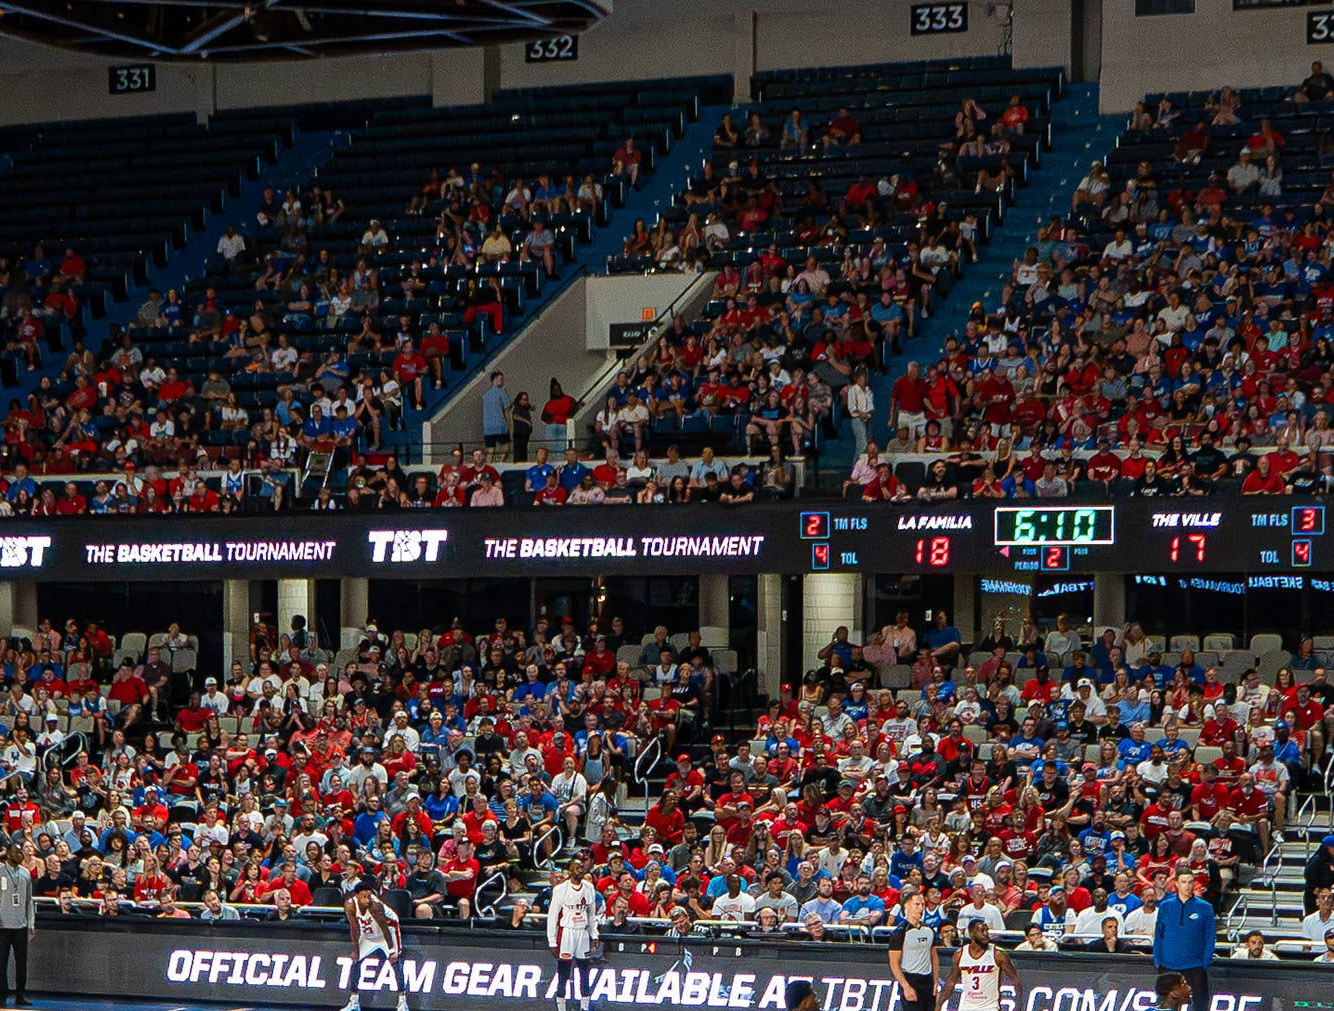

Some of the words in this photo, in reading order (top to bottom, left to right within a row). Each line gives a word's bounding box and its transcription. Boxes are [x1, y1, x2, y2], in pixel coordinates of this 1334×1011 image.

[915, 4, 964, 31] 333
[529, 33, 574, 59] 332
[116, 67, 150, 91] 331
[806, 514, 822, 537] 2
[897, 516, 916, 530] LA
[916, 515, 972, 530] FAMILIA
[1013, 509, 1096, 543] 6:10
[1152, 513, 1180, 527] THE
[1180, 512, 1222, 527] VILLE
[1251, 514, 1267, 527] TM
[1269, 514, 1289, 527] FLS
[1301, 508, 1316, 531] 3
[85, 544, 115, 564] THE
[117, 543, 223, 563] BASKETBALL
[225, 541, 337, 561] TOURNAMENT
[368, 529, 448, 563] TBT
[483, 538, 519, 559] THE
[520, 537, 638, 558] BASKETBALL
[640, 535, 765, 557] TOURNAMENT
[814, 545, 828, 564] 4
[841, 552, 859, 565] TOL
[915, 536, 950, 567] 18
[1046, 547, 1061, 568] 2
[1170, 533, 1206, 563] 17
[1260, 550, 1279, 564] TOL
[1294, 543, 1310, 562] 4
[166, 949, 327, 989] OFFICIAL
[335, 955, 437, 993] TEAM
[443, 961, 543, 999] GEAR
[971, 976, 980, 990] 3
